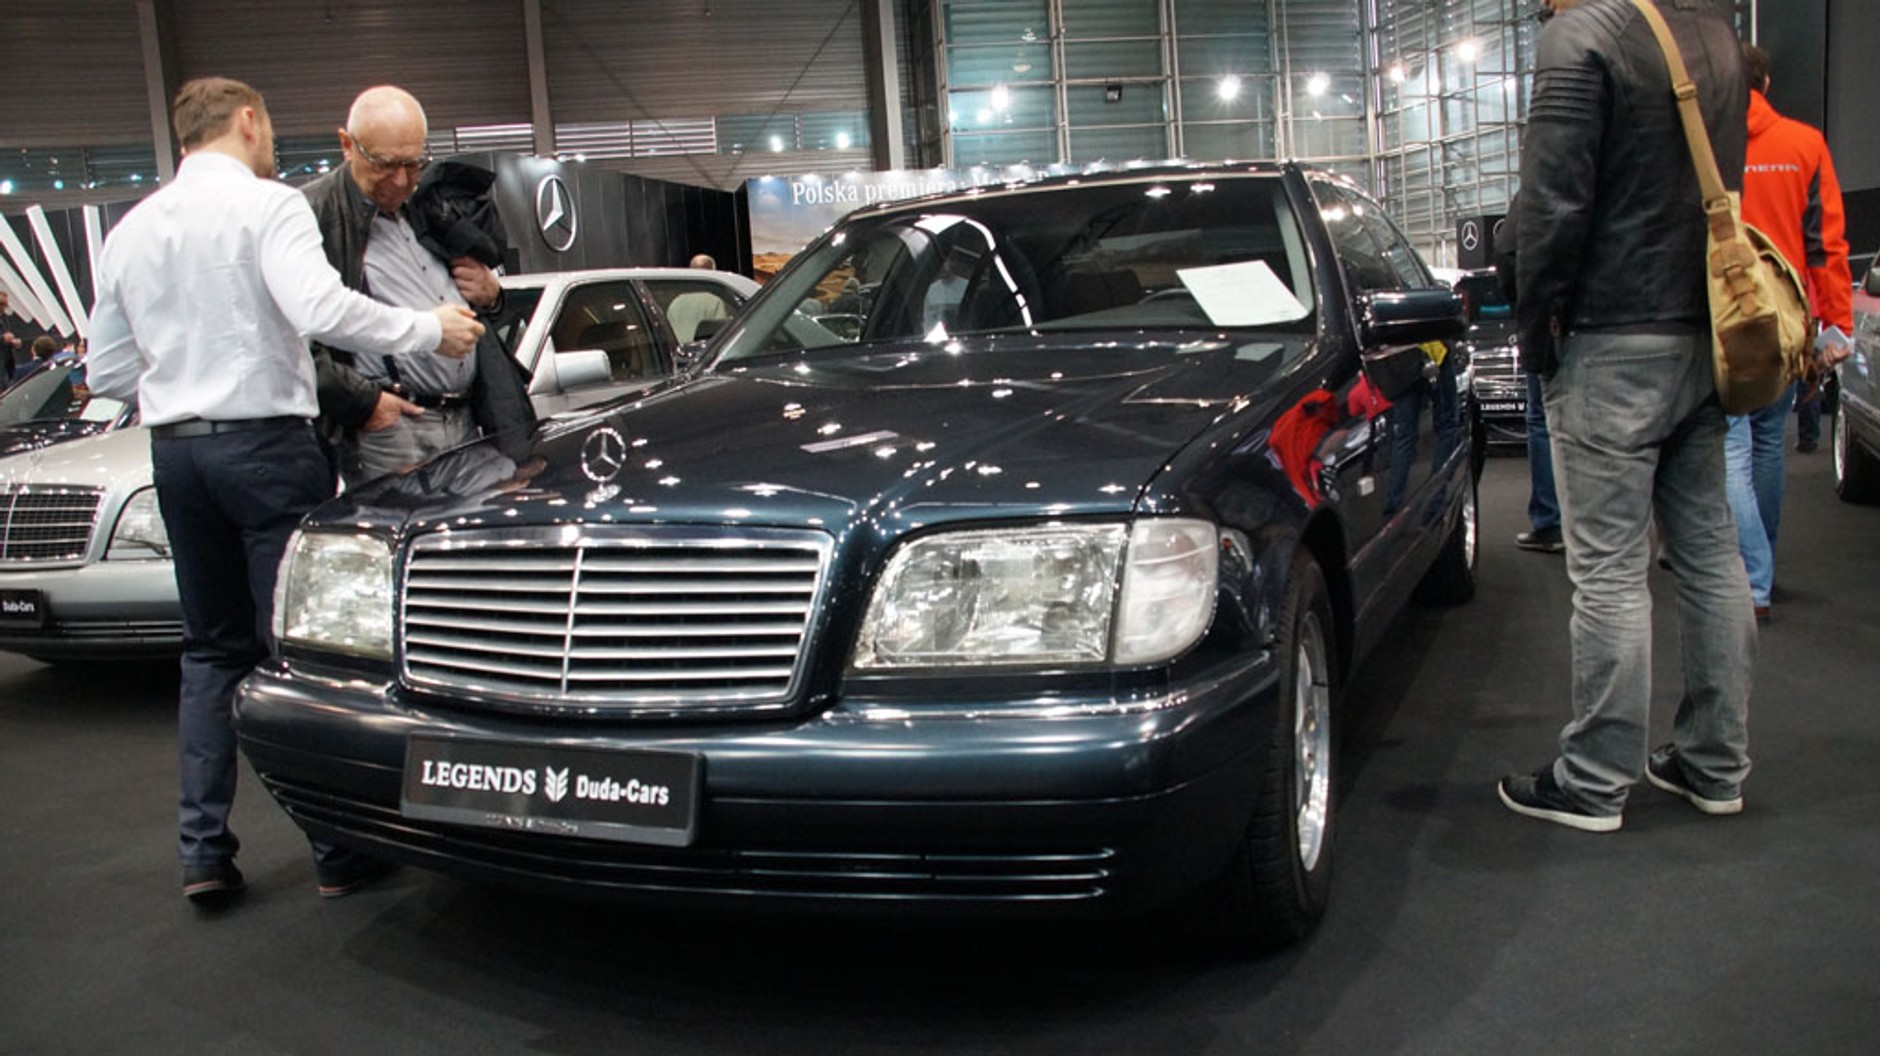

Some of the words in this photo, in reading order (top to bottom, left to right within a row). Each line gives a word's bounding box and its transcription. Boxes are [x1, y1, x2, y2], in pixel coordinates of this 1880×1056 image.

[793, 180, 858, 205] Polska
[422, 760, 536, 795] LEGENDS
[576, 775, 669, 806] Duda-Cars
